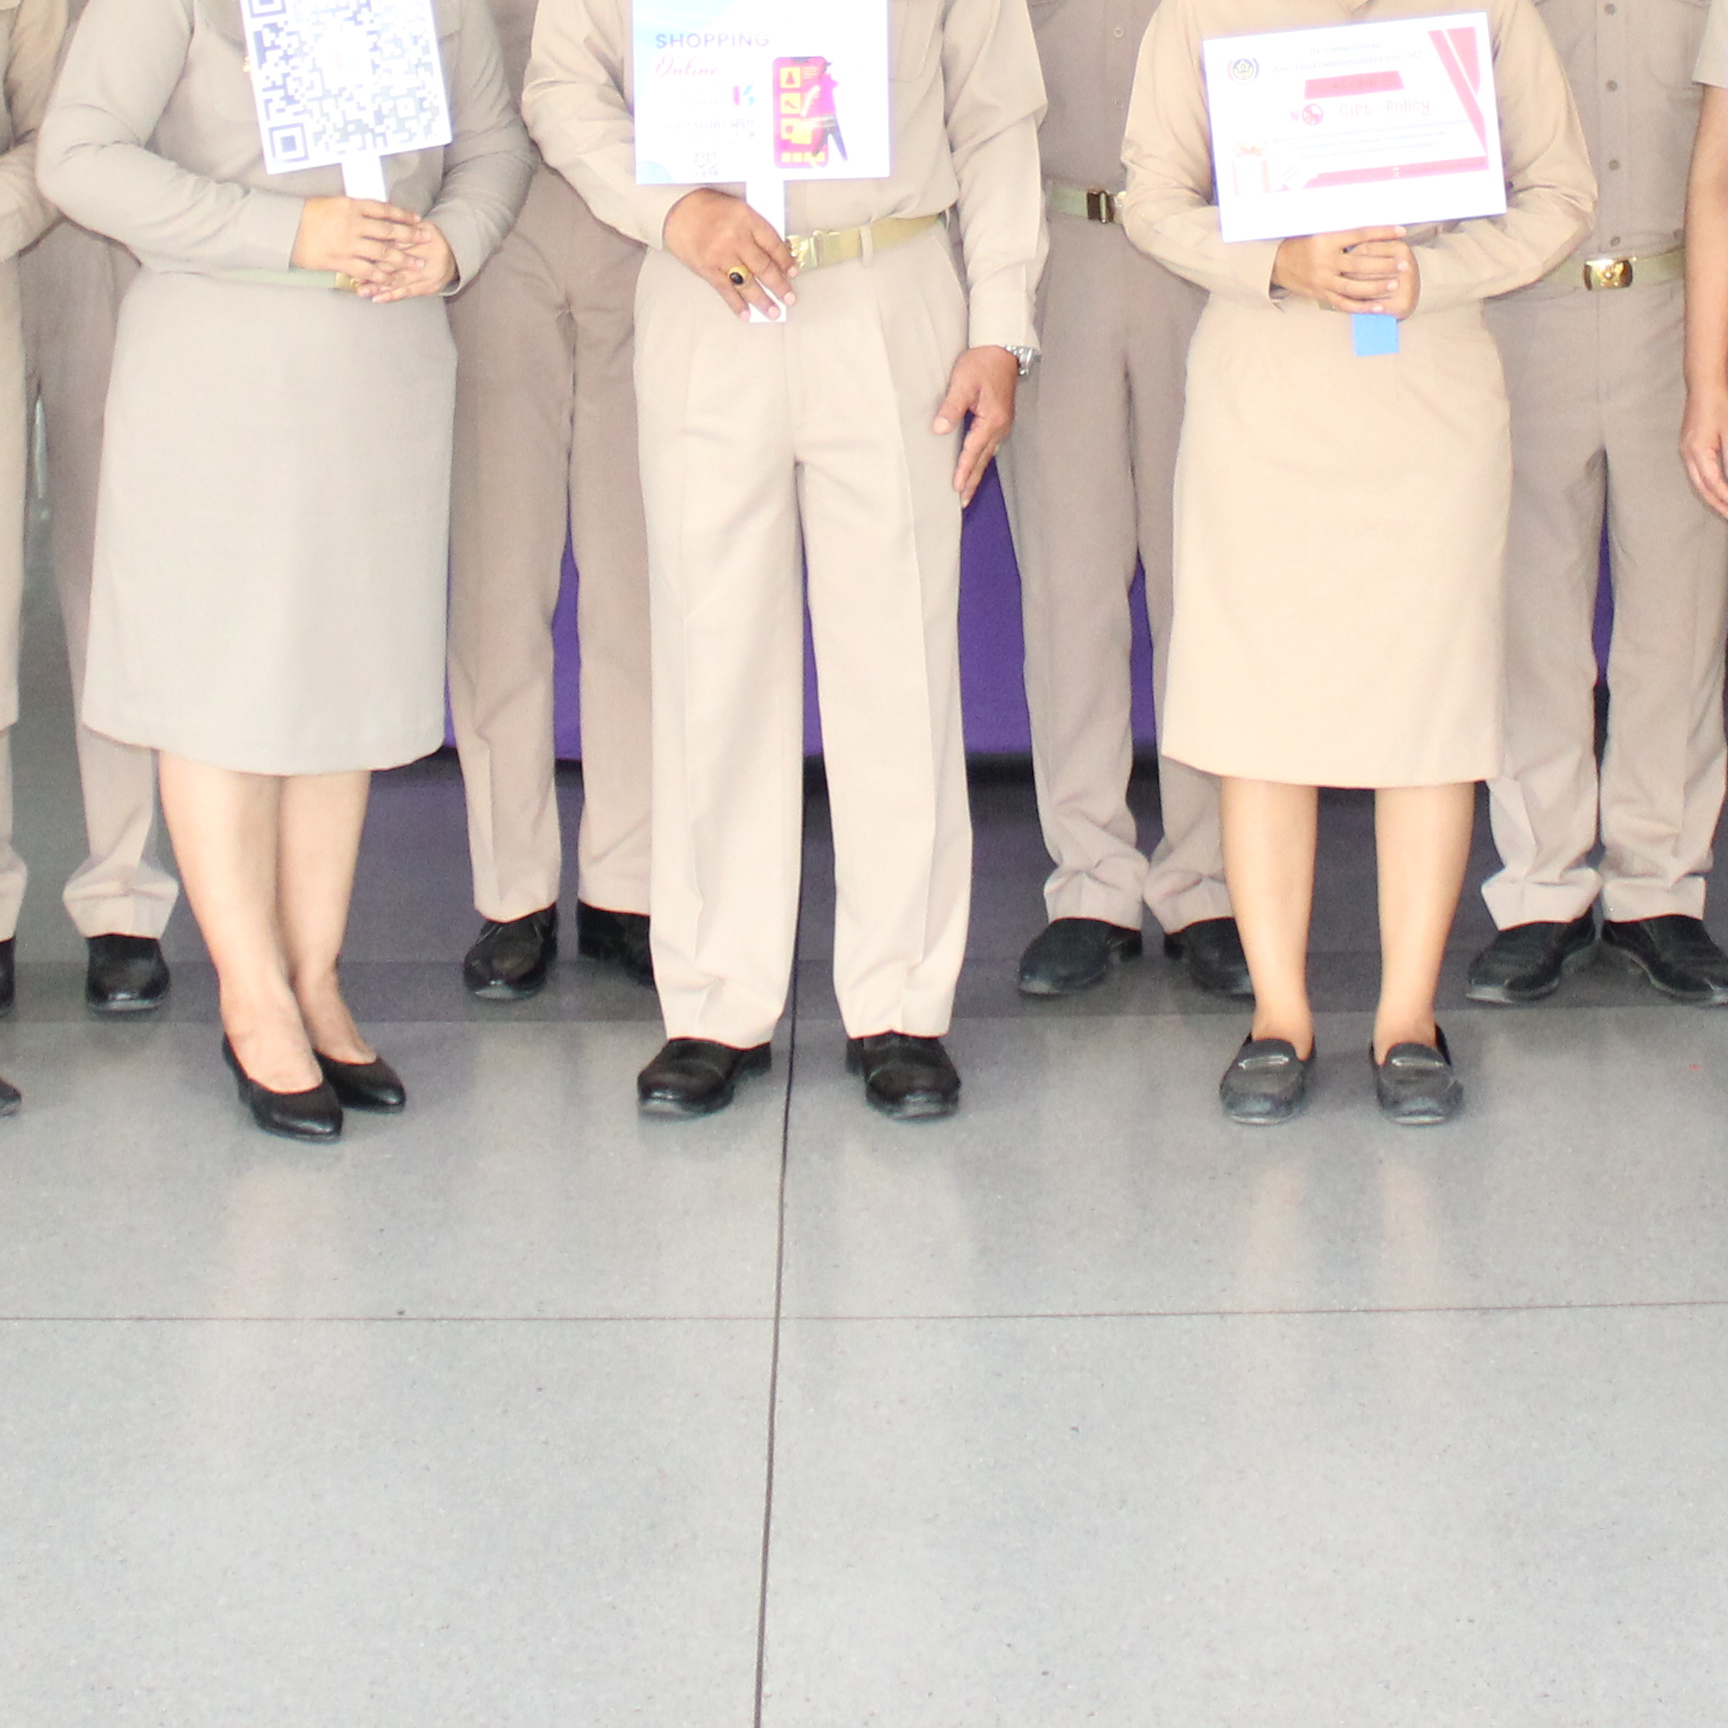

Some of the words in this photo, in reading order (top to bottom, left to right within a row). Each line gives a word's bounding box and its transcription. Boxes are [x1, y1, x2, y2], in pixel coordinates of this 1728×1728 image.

[655, 31, 770, 50] SHOPPING
[654, 53, 720, 78] Online
[1339, 101, 1373, 120] Gift
[1386, 97, 1431, 118] Policy
